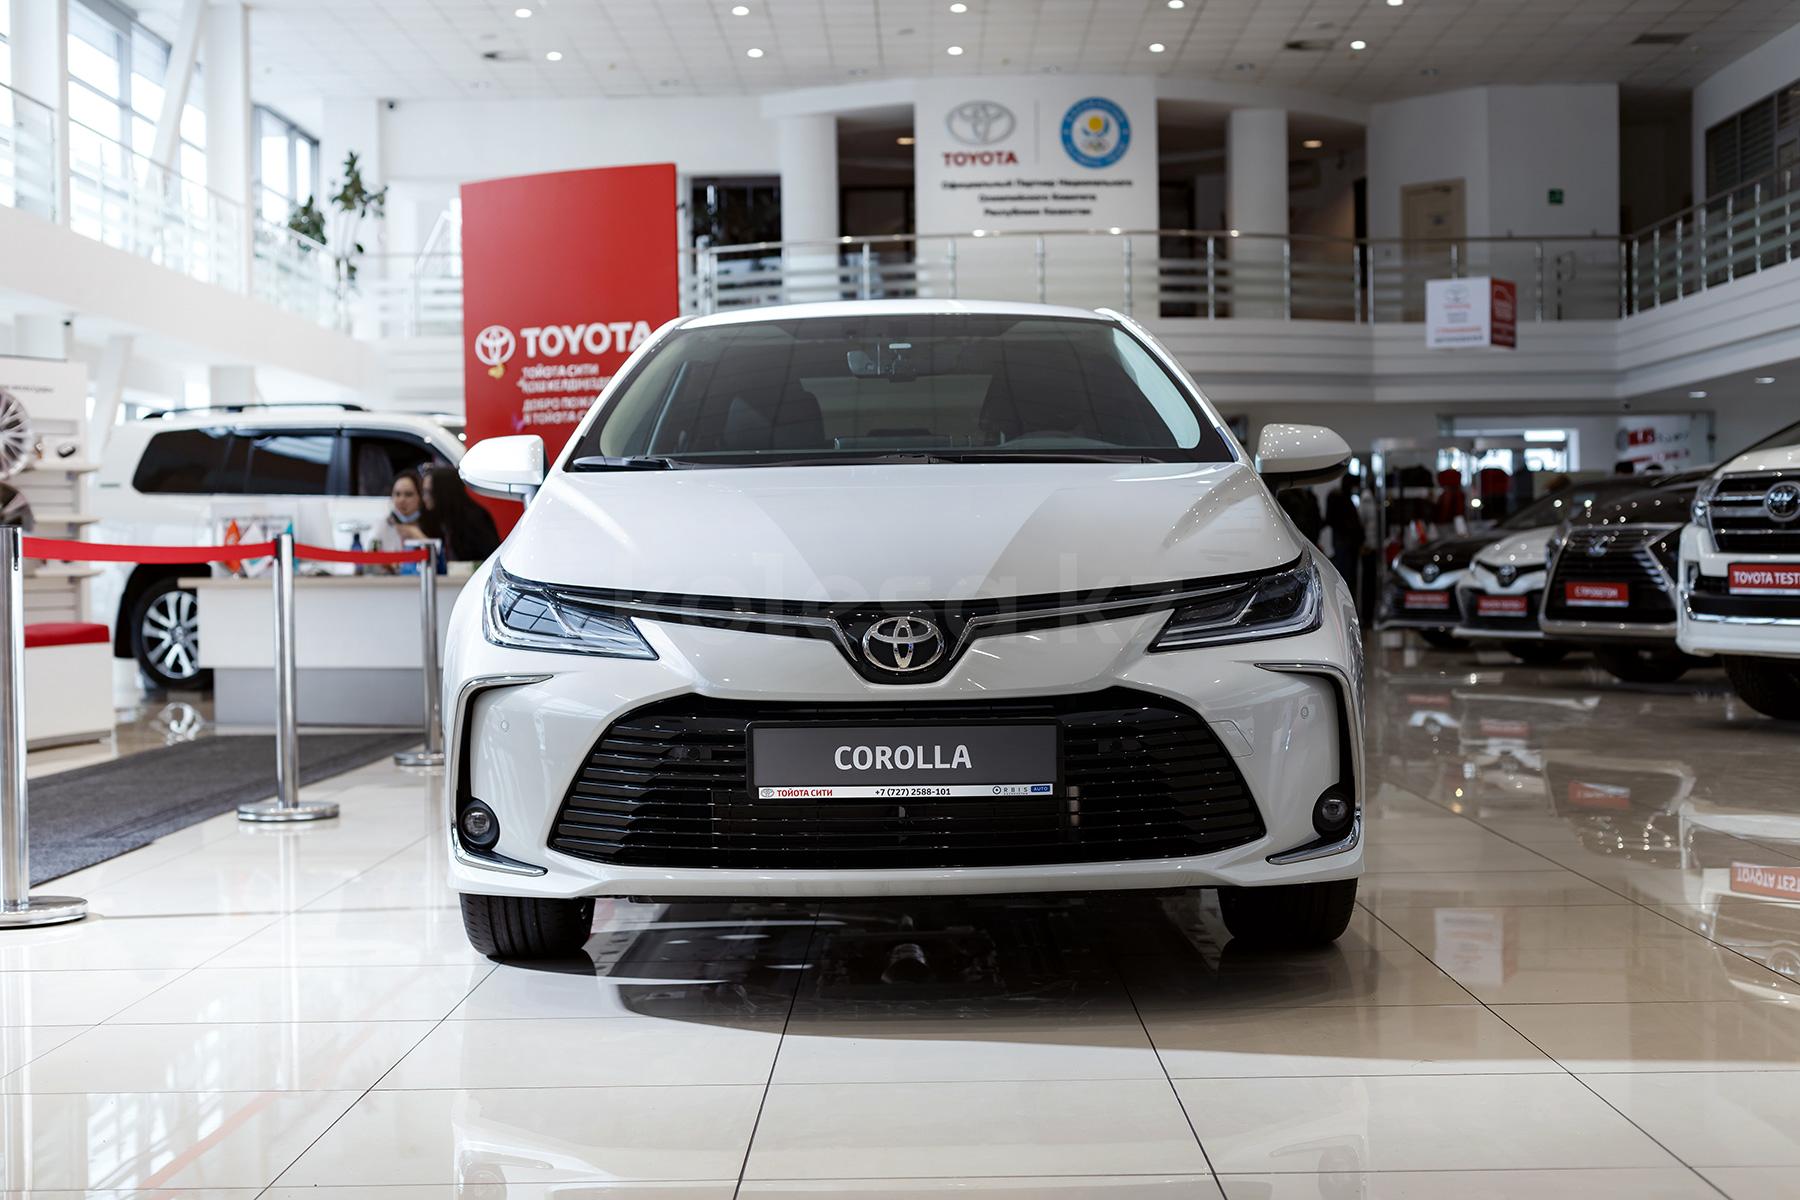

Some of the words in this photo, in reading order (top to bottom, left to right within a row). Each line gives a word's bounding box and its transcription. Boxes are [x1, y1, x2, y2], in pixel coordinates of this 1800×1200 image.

[943, 151, 1017, 166] TOYOTA
[520, 321, 651, 358] TOYOTA
[1733, 571, 1773, 585] TOYOTA
[834, 744, 972, 770] COROLLA
[777, 787, 810, 797] ТОЙОТА
[811, 788, 833, 797] СИТИ
[875, 788, 885, 796] +7
[887, 788, 909, 797] (727)
[911, 787, 951, 797] 2588-101
